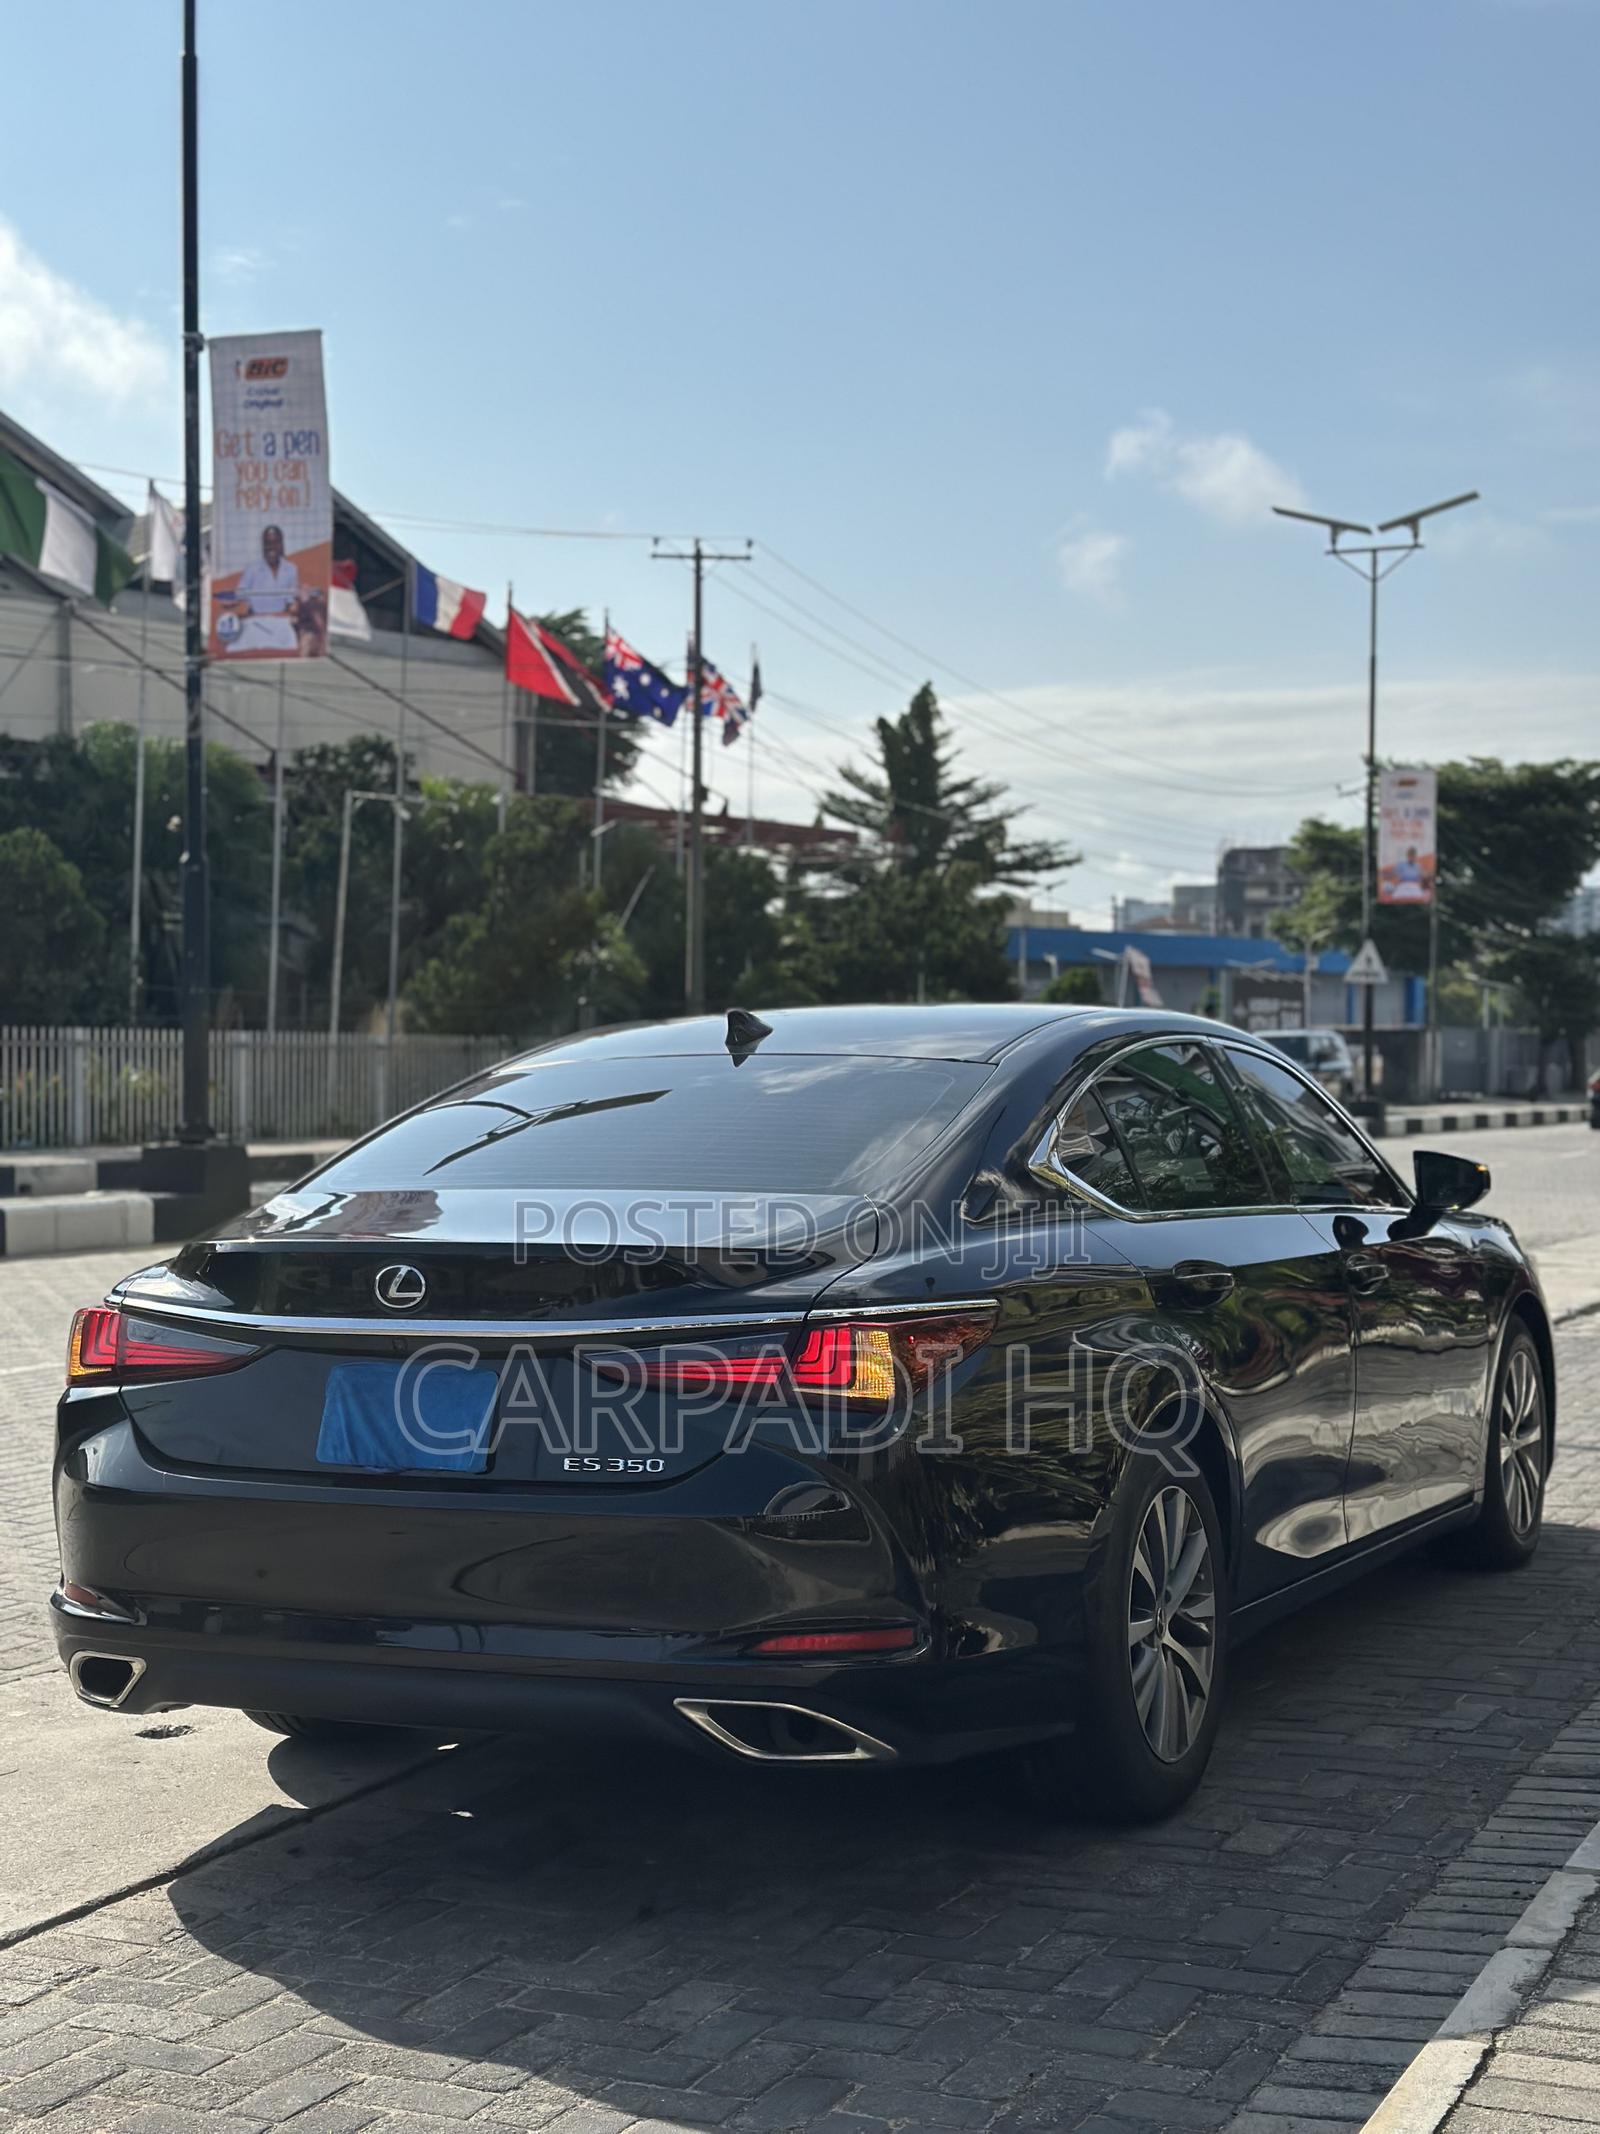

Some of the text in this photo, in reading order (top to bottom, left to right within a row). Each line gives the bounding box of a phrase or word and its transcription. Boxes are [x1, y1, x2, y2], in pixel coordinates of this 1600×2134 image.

[214, 429, 321, 459] Get a pen
[234, 459, 309, 485] you can
[235, 482, 272, 512] rely
[563, 1457, 665, 1473] ES 350
